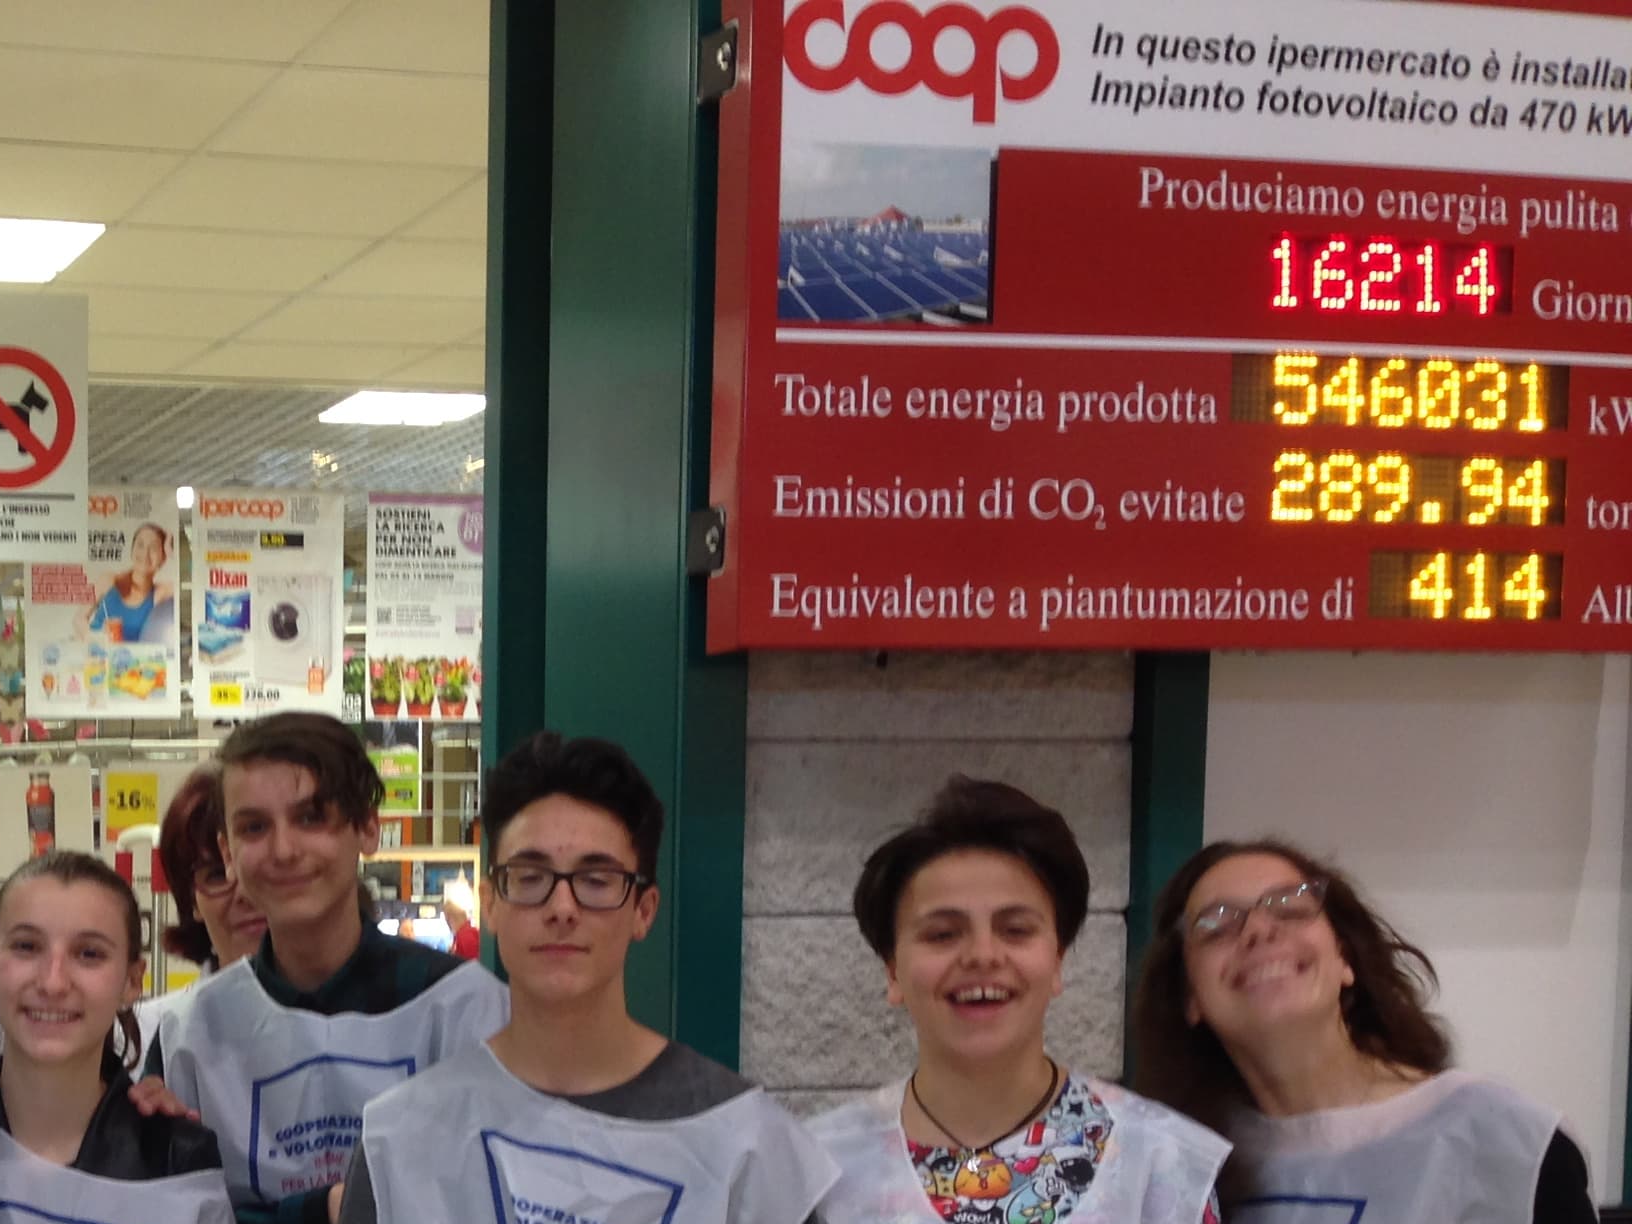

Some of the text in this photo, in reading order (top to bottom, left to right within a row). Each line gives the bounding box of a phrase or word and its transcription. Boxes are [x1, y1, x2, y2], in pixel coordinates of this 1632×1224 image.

[782, 0, 1060, 124] coop
[1091, 24, 1632, 93] In questo ipermercato è installa
[1091, 72, 1245, 116] Impianto
[1256, 82, 1458, 126] fotovoltaico
[1469, 96, 1509, 129] da
[1519, 101, 1577, 133] 470
[1138, 166, 1364, 217] Produciamo
[1376, 183, 1509, 233] energia
[1520, 194, 1619, 238] pulita
[1272, 234, 1495, 315] 16214
[774, 373, 1218, 433] Totale energia prodotta
[1272, 352, 1545, 432] 546031
[376, 508, 431, 520] SOSTIENI
[773, 475, 966, 519] Emissioni
[978, 478, 1015, 520] di
[1119, 480, 1245, 523] evitate
[1271, 450, 1549, 527] 289.94
[376, 522, 445, 534] LA RICERCA
[376, 535, 432, 546] PER NON
[376, 547, 456, 558] DIMENTICARE
[210, 568, 247, 588] Dixan
[771, 573, 1354, 633] Equivalente a piantumazione di
[1410, 550, 1545, 620] 414
[109, 789, 155, 810] -16%
